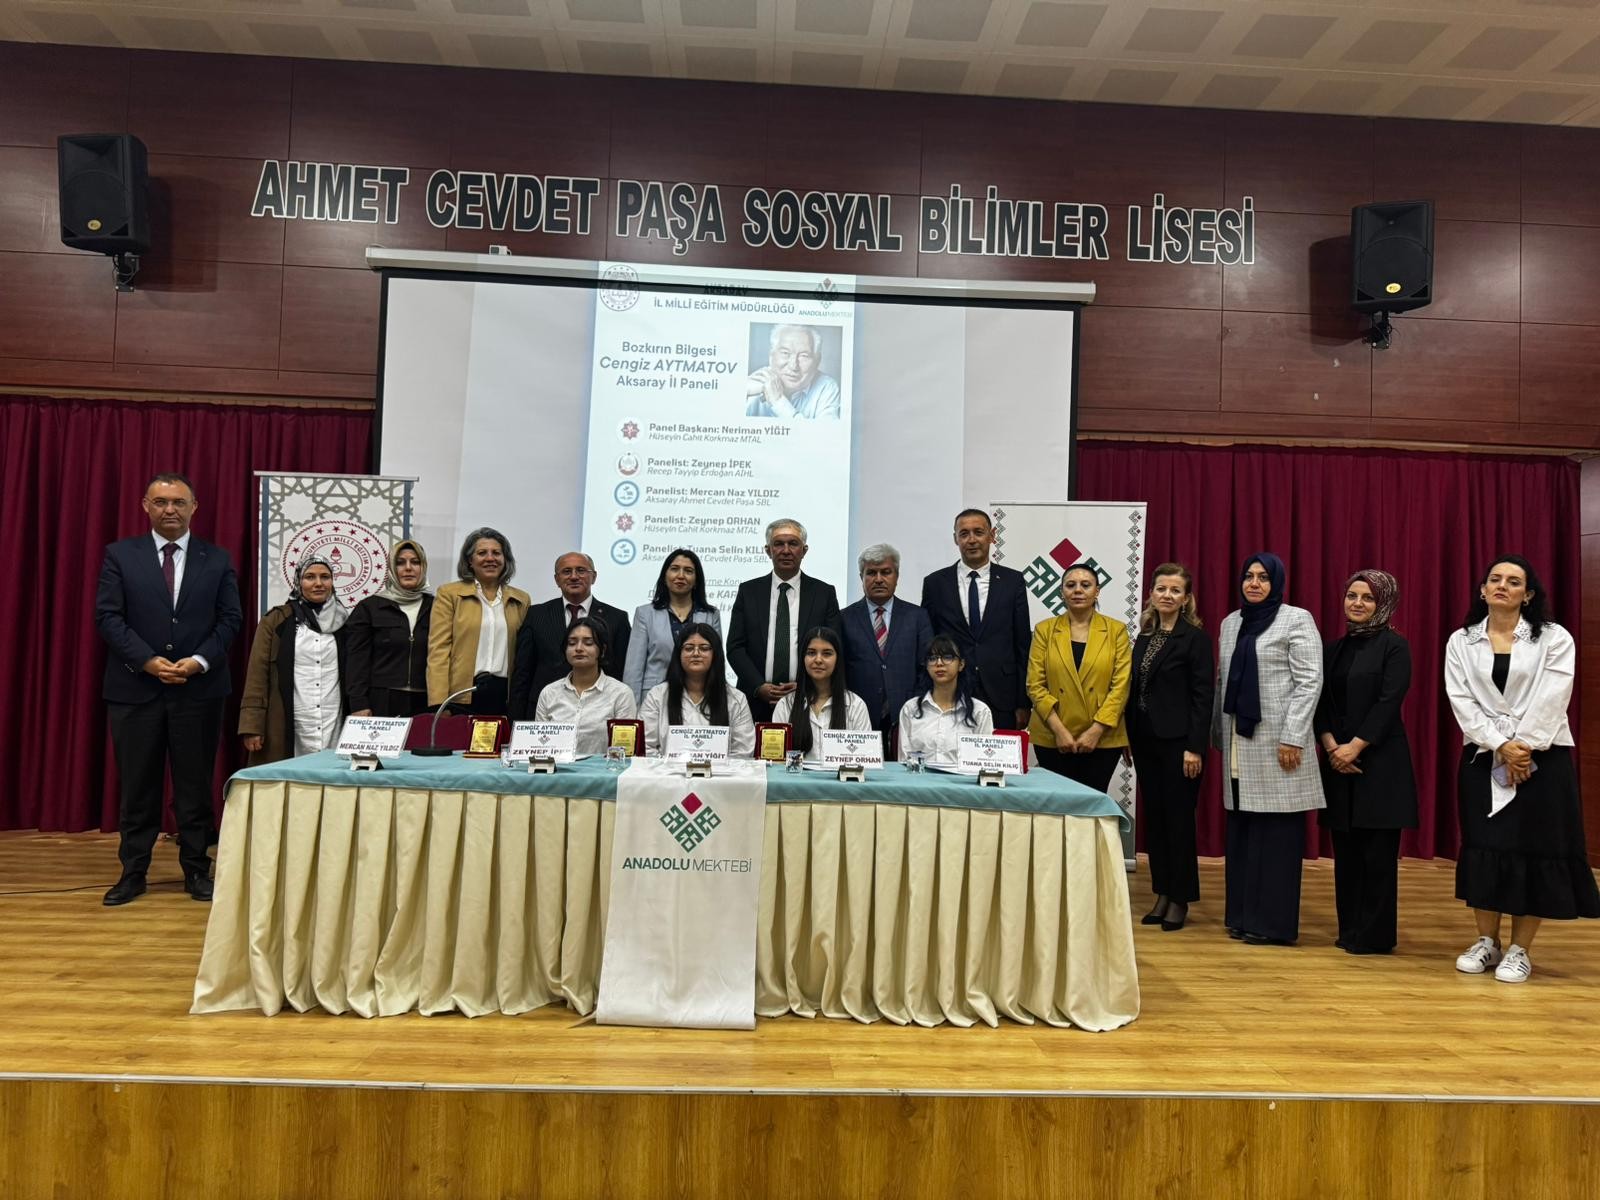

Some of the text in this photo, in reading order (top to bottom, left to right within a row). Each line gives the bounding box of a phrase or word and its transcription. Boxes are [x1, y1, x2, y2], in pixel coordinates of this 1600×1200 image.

[251, 159, 1255, 265] AHMET CEVDET PAŞA SOSYAL BİLİMLER LİSESİ
[654, 296, 663, 308] İL
[694, 299, 729, 311] EĞİTİM
[731, 301, 795, 314] MÜDÜRLÜĞÜ
[622, 341, 717, 358] Bozkırın Bilgesi
[600, 356, 738, 374] Cengiz AYTMATOV
[616, 375, 667, 390] Aksaray
[680, 377, 718, 390] Paneli
[649, 423, 791, 436] Panel Başkanı: Neriman YİĞİT
[649, 432, 681, 442] Hüseyin
[703, 434, 739, 443] Korkmaz
[740, 435, 762, 444] MTAL
[647, 458, 752, 470] Panelist: Zeynep İPEK
[647, 467, 672, 476] Recep
[674, 467, 699, 477] Tayyip
[701, 468, 733, 478] Erdoğan
[646, 486, 780, 498] Panelist: Mercan Naz YILDIZ
[645, 496, 677, 505] Aksaray
[679, 496, 706, 505] Ahmet
[707, 497, 734, 506] Cevdet
[644, 515, 761, 527] Panelist: Zeynep ORHAN
[644, 525, 677, 534] Hüseyin
[700, 526, 735, 534] Korkmaz
[736, 526, 759, 534] MTAL
[719, 545, 744, 555] Selin
[745, 546, 765, 555] KILI
[704, 555, 733, 563] Cevdet
[825, 755, 854, 763] ZEYNEP
[622, 857, 752, 873] ANADOLU MEKTEBİ
